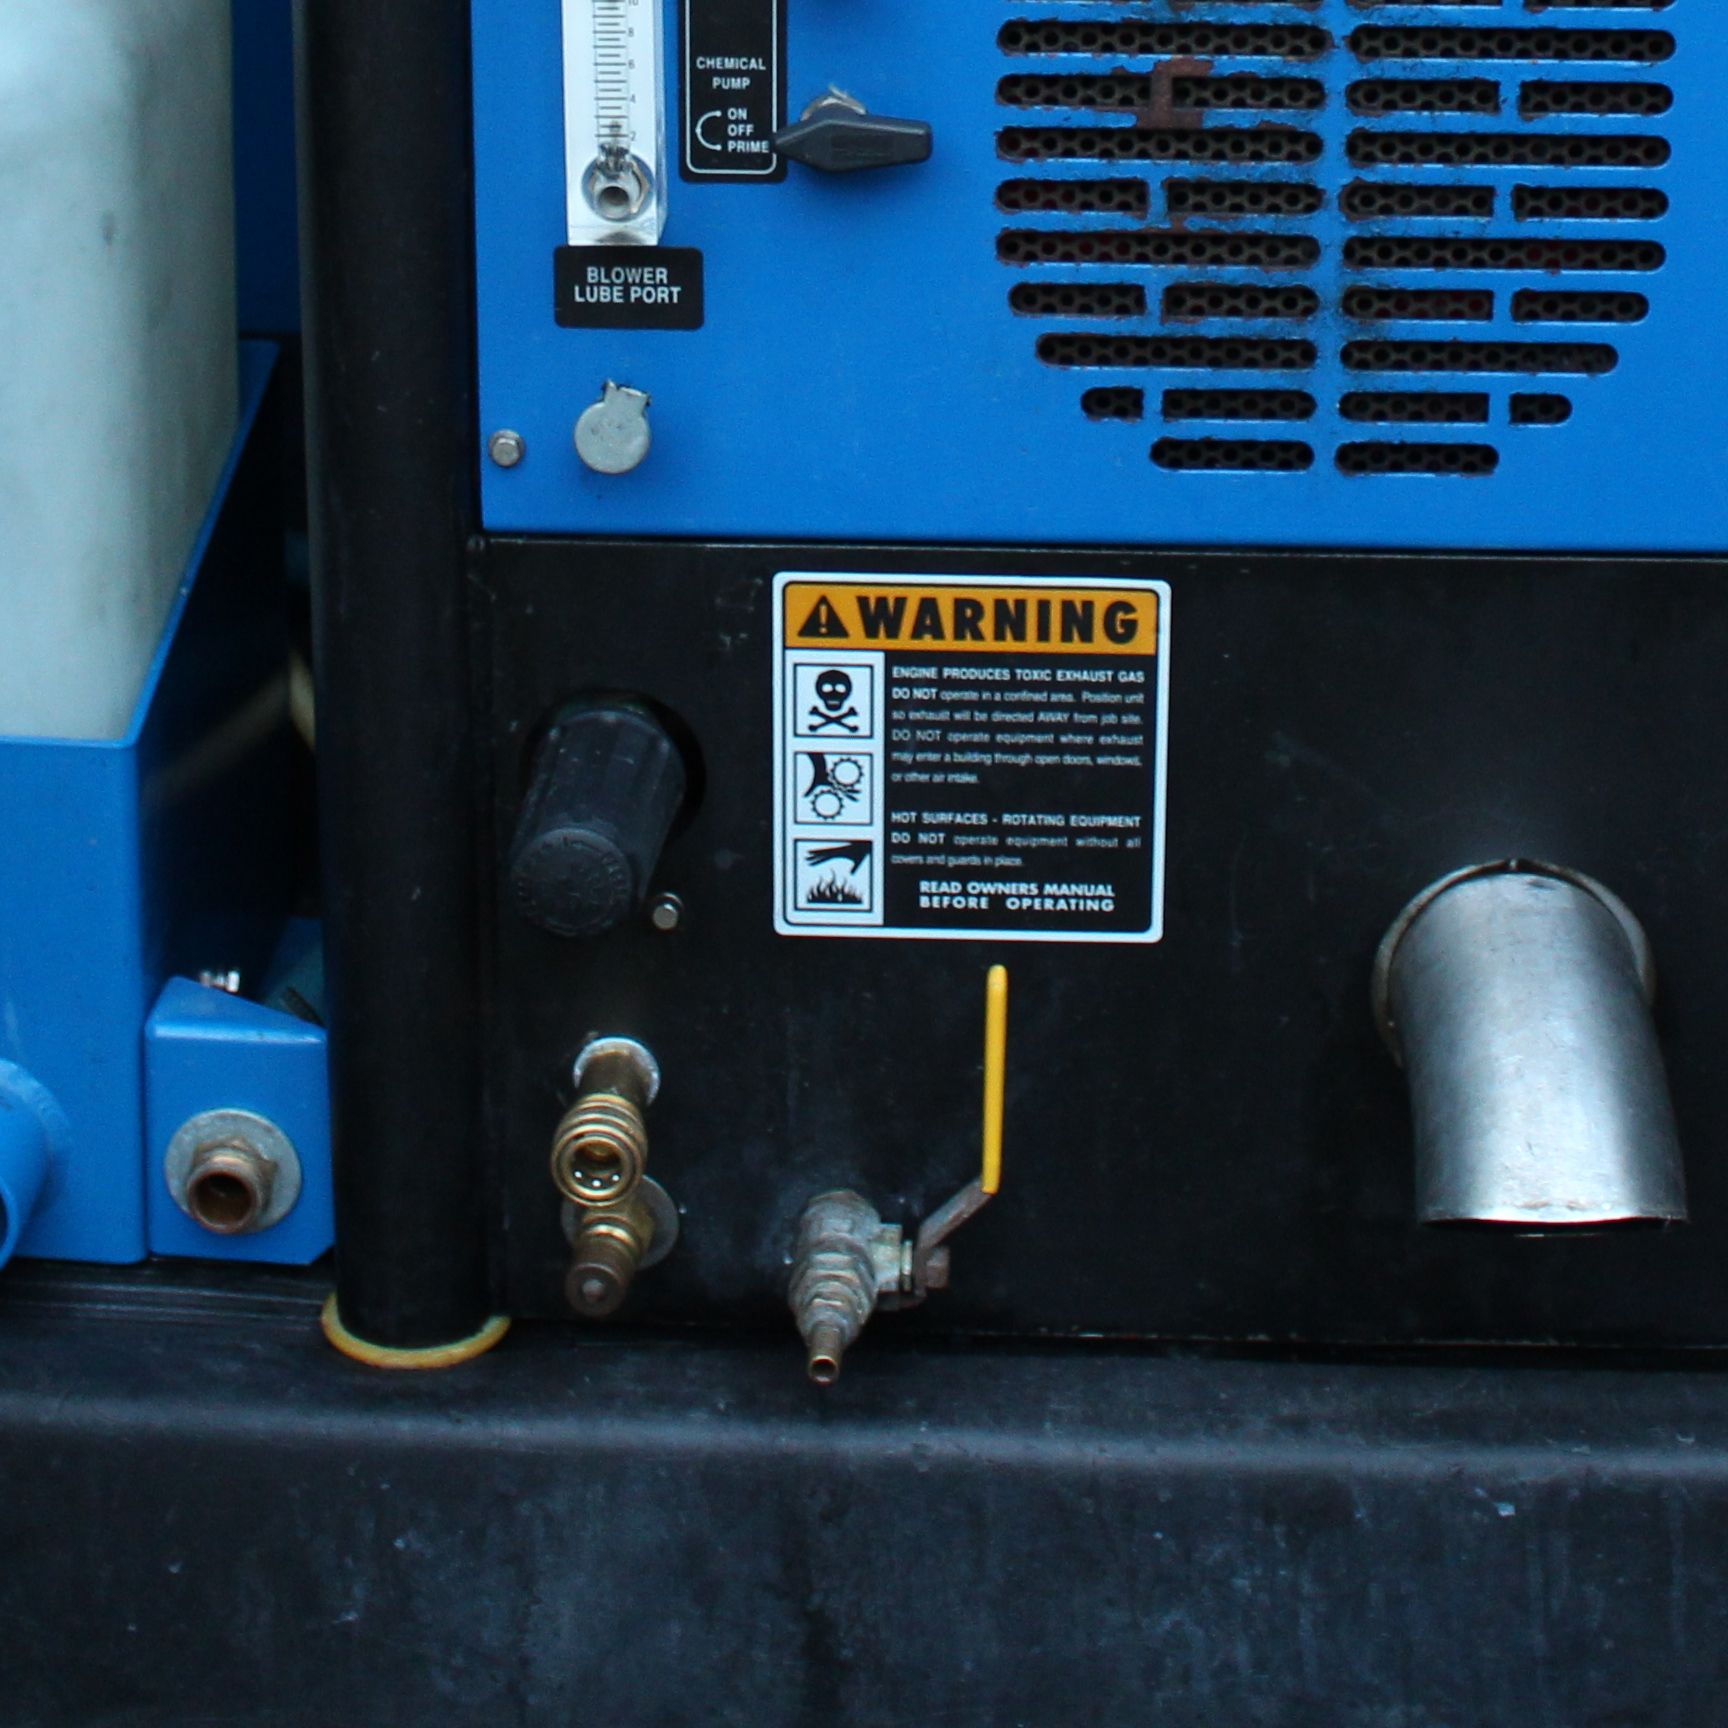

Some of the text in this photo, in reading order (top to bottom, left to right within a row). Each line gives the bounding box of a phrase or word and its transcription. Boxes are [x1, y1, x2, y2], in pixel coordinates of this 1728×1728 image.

[696, 57, 766, 71] CHEMICAL
[712, 76, 750, 90] PUMP
[727, 108, 748, 121] ON
[727, 124, 754, 137] OFF
[727, 140, 770, 154] PRIME
[586, 267, 668, 284] BLOWER
[574, 286, 681, 304] LUBE PORT
[856, 595, 1140, 645] WARNING
[892, 666, 1145, 684] ENGINE PRODUCES TOXIC EXHAUST GAS
[892, 687, 910, 700] DO
[912, 687, 938, 700] NOT
[892, 728, 911, 741] DO
[915, 728, 941, 741] NOT
[891, 811, 917, 824] HOT
[921, 812, 988, 825] SURFACES
[1001, 813, 1065, 826] ROTATING
[1069, 815, 1141, 827] EQUIPMENT
[891, 832, 911, 844] DO
[918, 832, 945, 845] NOT
[919, 880, 1115, 897] READ OWNERS MANUAL
[919, 896, 1115, 912] BEFORE OPERATING
